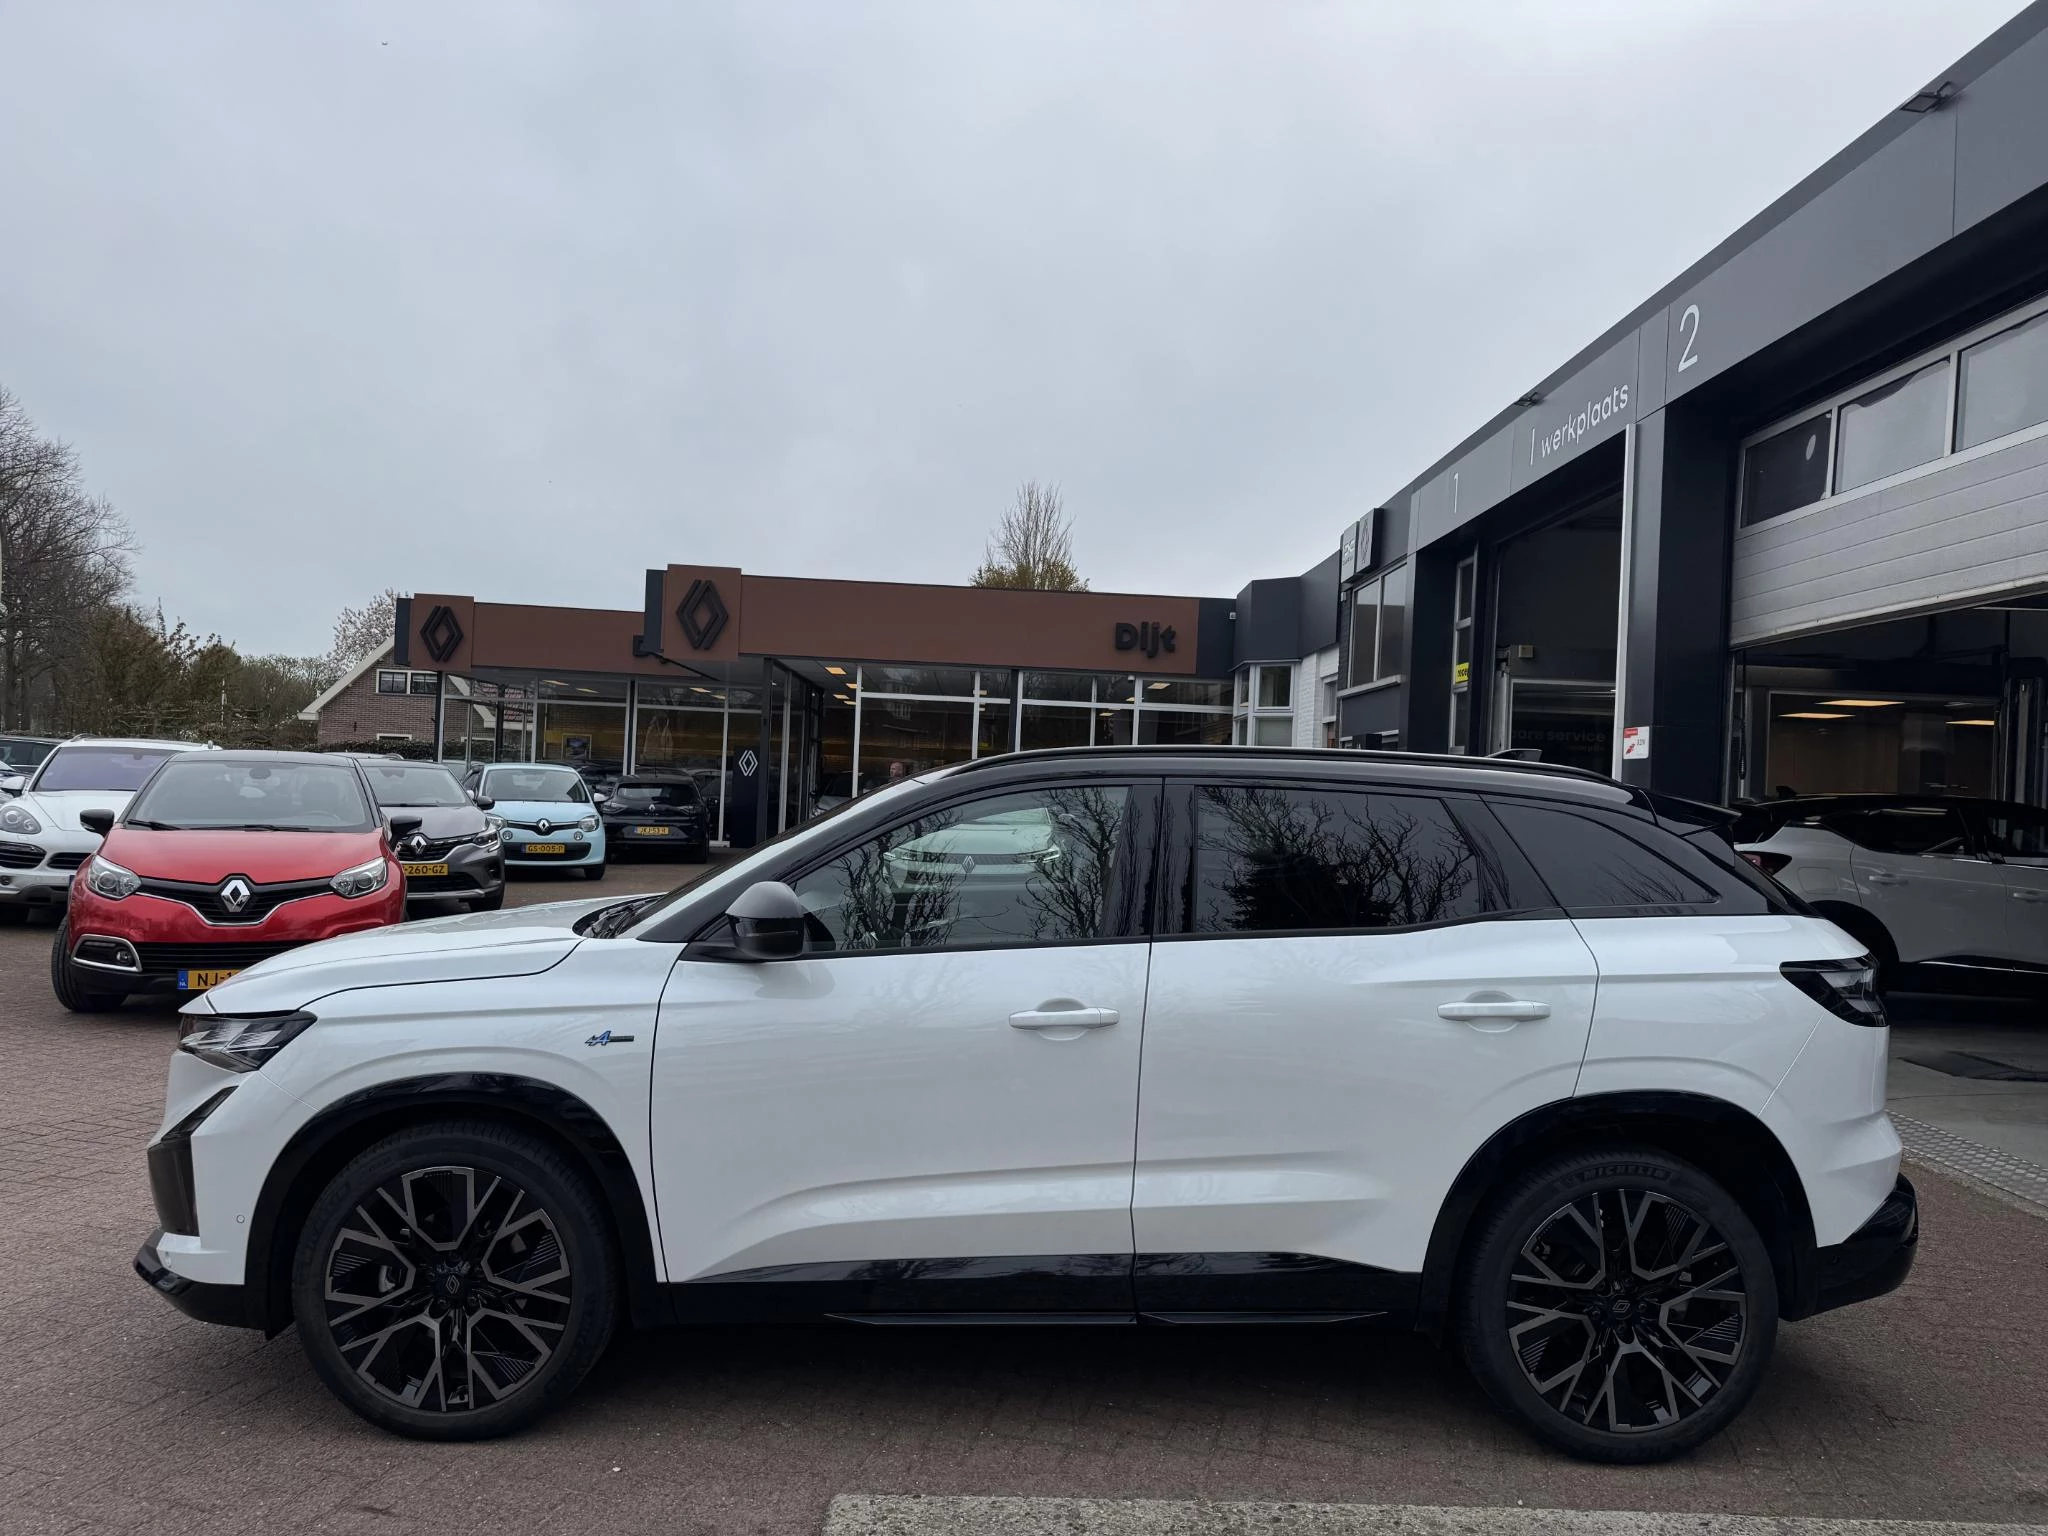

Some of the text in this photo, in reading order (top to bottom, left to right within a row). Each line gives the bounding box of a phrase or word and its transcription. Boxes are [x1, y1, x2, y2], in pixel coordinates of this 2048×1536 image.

[1678, 304, 1700, 373] 2
[1540, 384, 1629, 458] werkplaats
[1453, 472, 1459, 513] 1
[1116, 621, 1177, 658] Dijt
[402, 864, 445, 875] -260-GZ
[1583, 1164, 1667, 1182] MICHELIN
